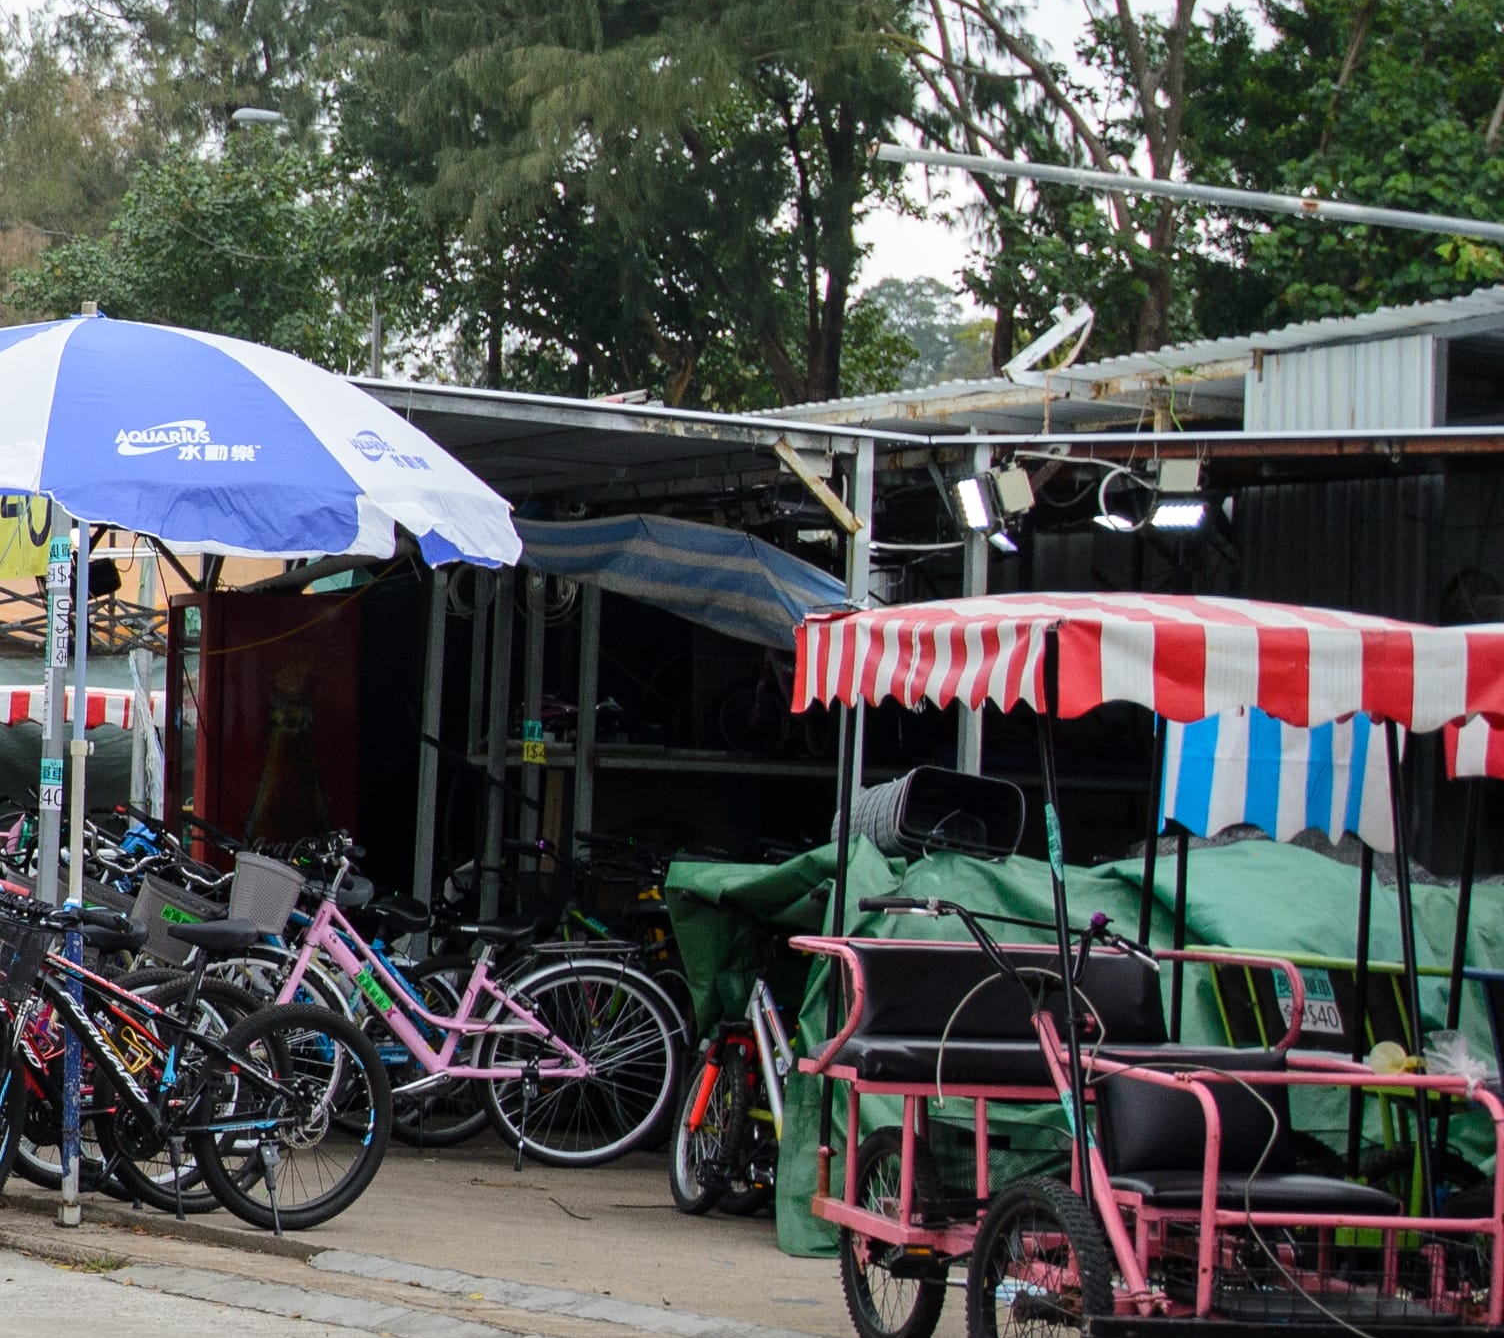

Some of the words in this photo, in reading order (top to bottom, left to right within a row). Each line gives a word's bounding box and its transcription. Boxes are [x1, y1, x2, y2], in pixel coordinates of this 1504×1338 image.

[115, 427, 212, 444] AQUARIUS
[177, 444, 256, 462] 水動樂
